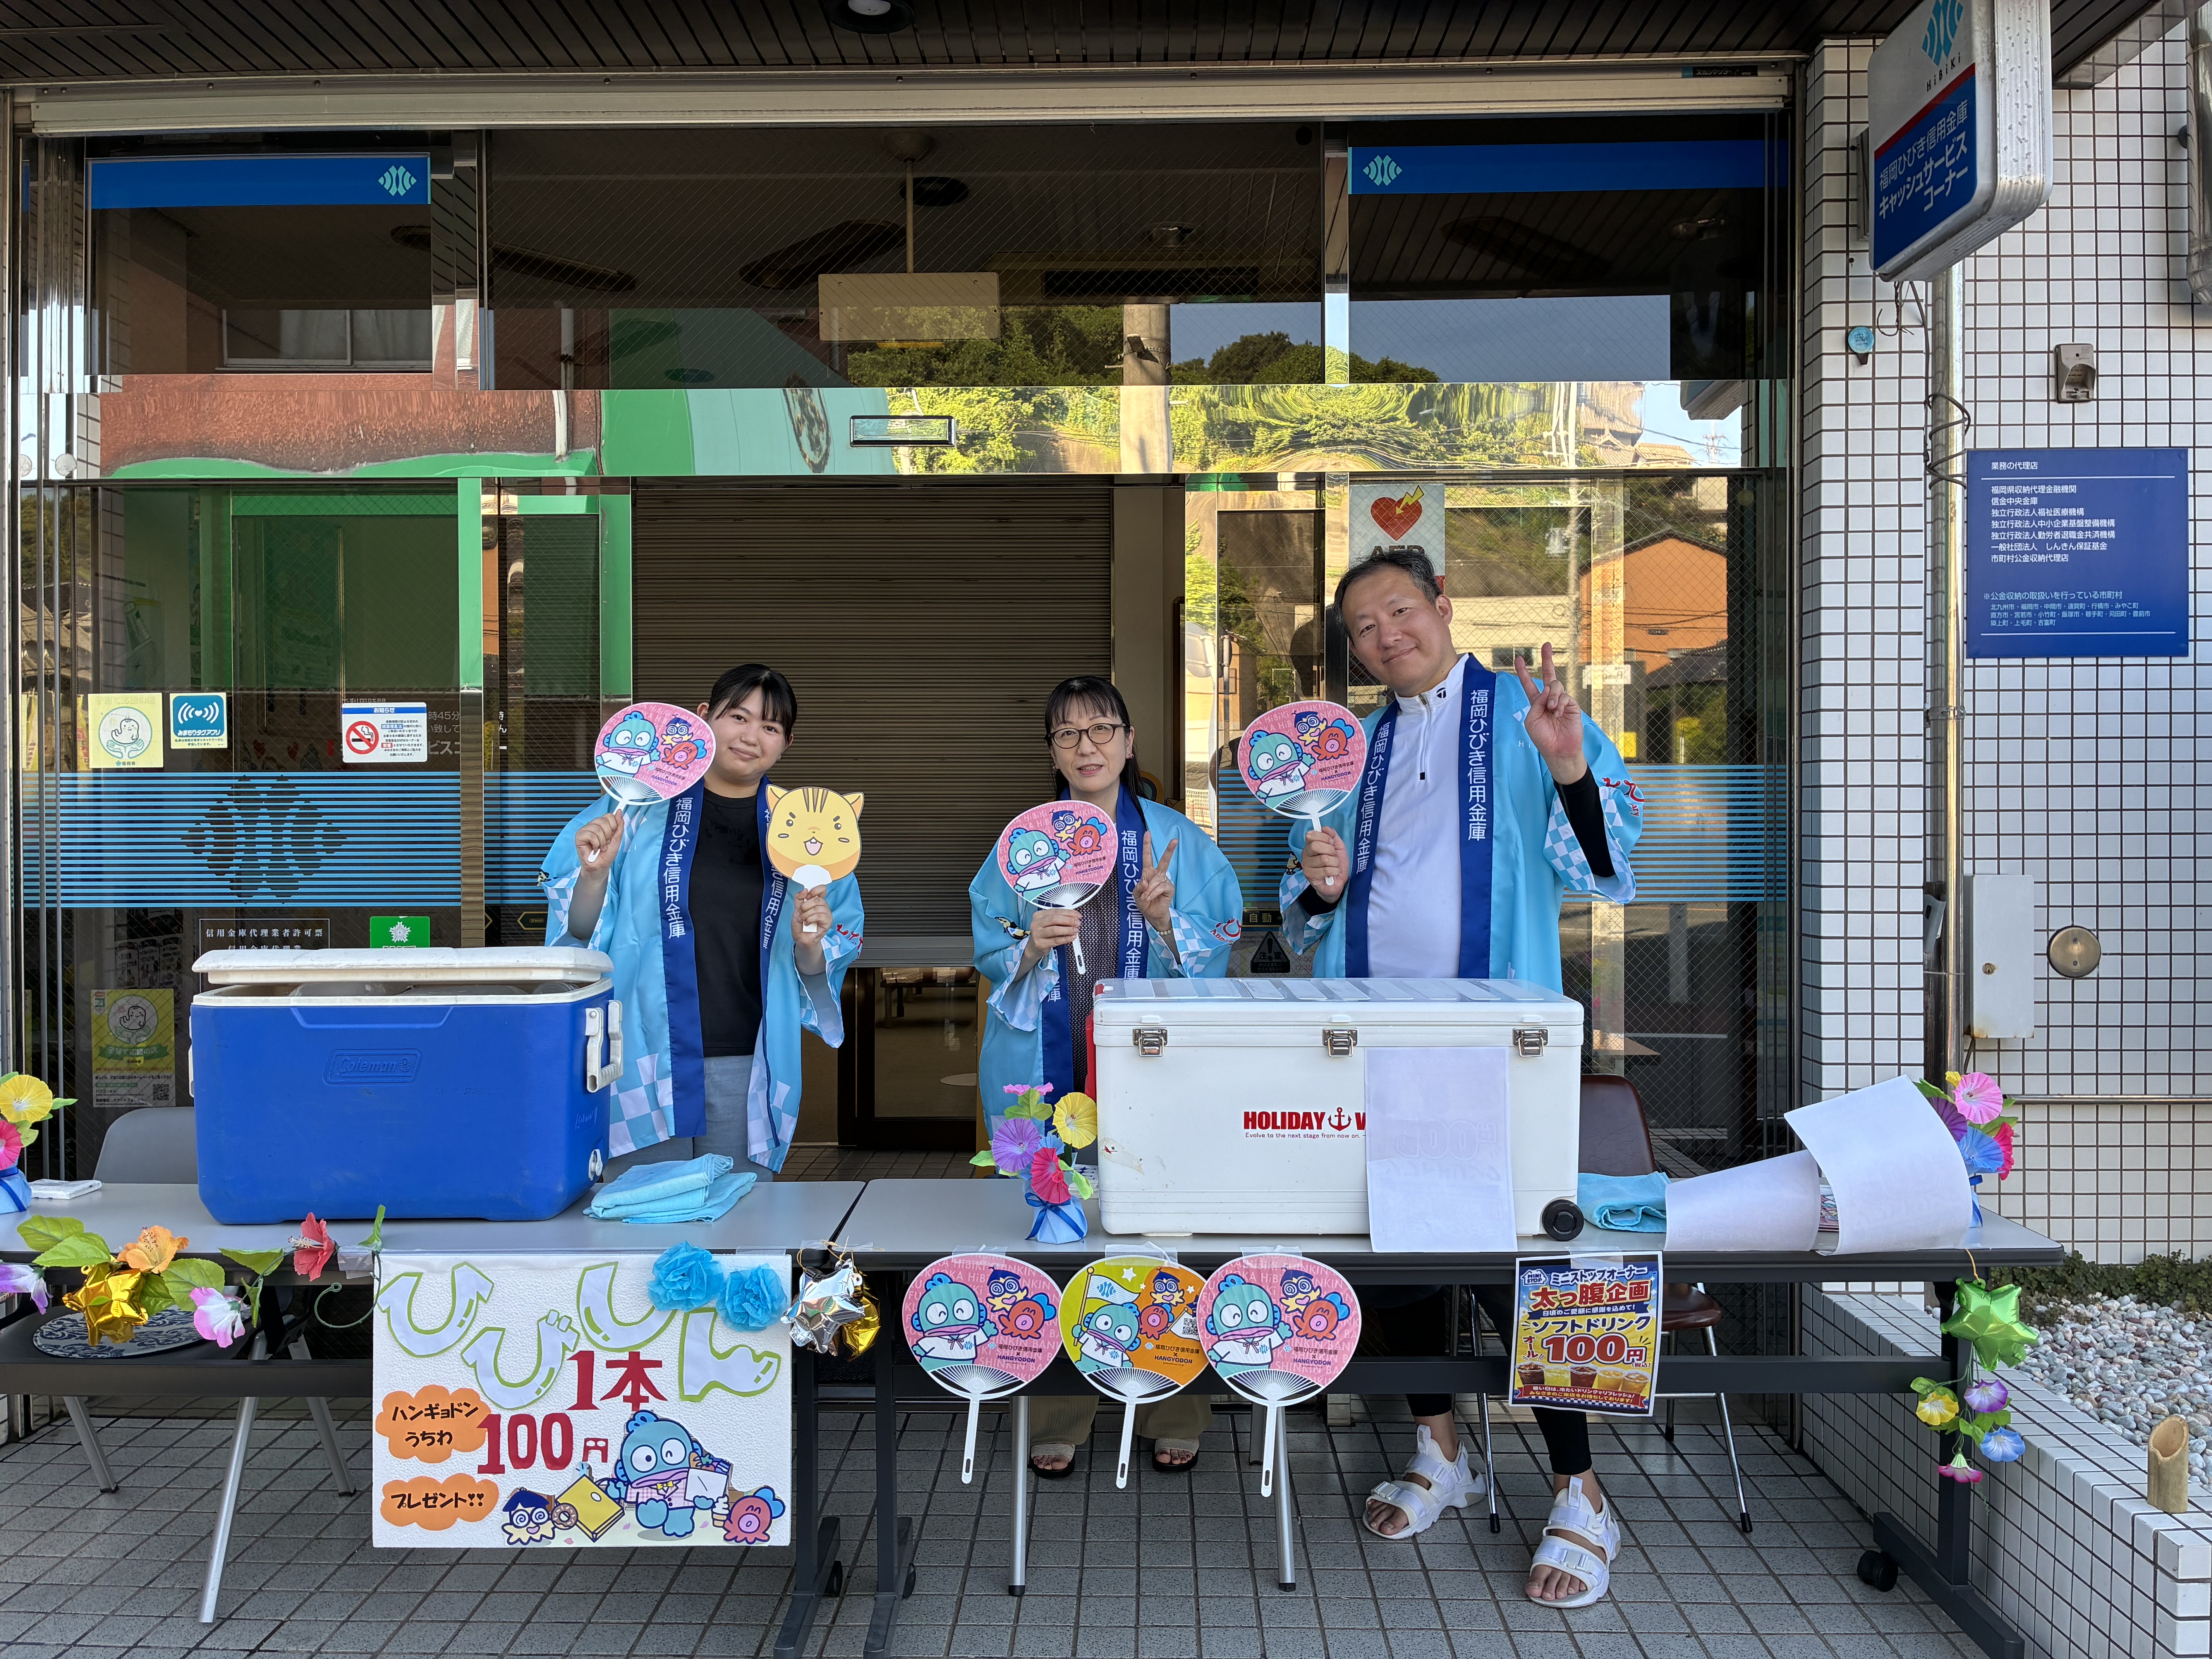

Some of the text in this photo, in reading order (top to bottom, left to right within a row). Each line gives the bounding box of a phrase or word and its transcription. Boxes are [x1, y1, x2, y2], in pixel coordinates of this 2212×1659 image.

[1879, 100, 1968, 191] 福岡ひびき信用金庫
[1879, 131, 1967, 220] キャッシュサービス
[1923, 166, 1968, 212] コーナー
[1991, 462, 2038, 470] 業務の代理店
[1991, 485, 2077, 494] 福岡県収納代理金融機関
[1991, 497, 2038, 505] 信金中央金庫
[1991, 508, 2085, 517] 独立行政法人福祉医療機構
[1991, 542, 2108, 551] 一般社団法人 しんきん保証基金
[1991, 554, 2069, 563] 市町村公金収納代理店
[1467, 689, 1490, 842] 福岡ひびき信用金庫
[1321, 771, 1351, 781] HANGYODON
[1356, 722, 1390, 874] 福岡ひびき信用金庫
[663, 797, 694, 939] 福岡ひびき信用金庫
[1076, 866, 1103, 874] HANGYODON
[1250, 913, 1271, 923] 自動
[206, 929, 323, 937] 信用金庫代理業者許可票
[339, 1057, 397, 1073] Coleman
[1244, 1111, 1326, 1130] HOLIDAY
[1551, 1266, 1648, 1285] ミニストップオーナー
[1531, 1281, 1649, 1309] 太っ腹企画
[1532, 1316, 1651, 1333] ソフトドリンク
[998, 1344, 1042, 1353] 福岡ひびき信用金庫
[1155, 1345, 1200, 1354] 福岡ひびき信用金庫
[1294, 1346, 1338, 1355] 福岡ひびき信用金庫
[1523, 1336, 1539, 1358] オール
[998, 1355, 1035, 1363] HANGYODON
[1155, 1355, 1192, 1364] HANGYODON
[1293, 1358, 1331, 1366] HANGYODON
[566, 1350, 668, 1411] 1本
[391, 1401, 479, 1422] ハンギョドン
[405, 1430, 453, 1447] うちわ
[477, 1412, 608, 1474] 100円
